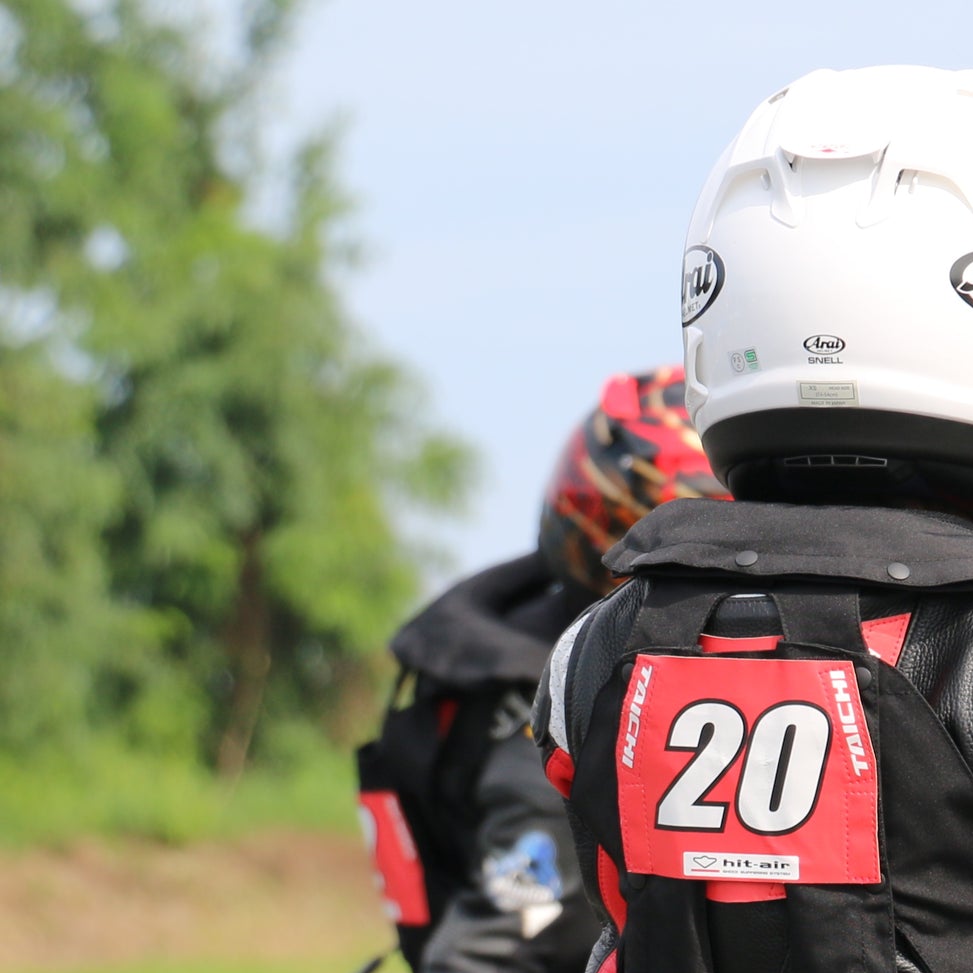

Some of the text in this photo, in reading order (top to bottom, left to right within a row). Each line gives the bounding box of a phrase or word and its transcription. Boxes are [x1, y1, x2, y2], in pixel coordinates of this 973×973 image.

[683, 251, 714, 304] rai
[806, 336, 841, 349] Arai
[808, 356, 843, 364] SNELL
[622, 665, 653, 768] TAICHI
[829, 670, 869, 776] TAICHI
[654, 698, 833, 836] 20
[723, 859, 791, 869] hit-air
